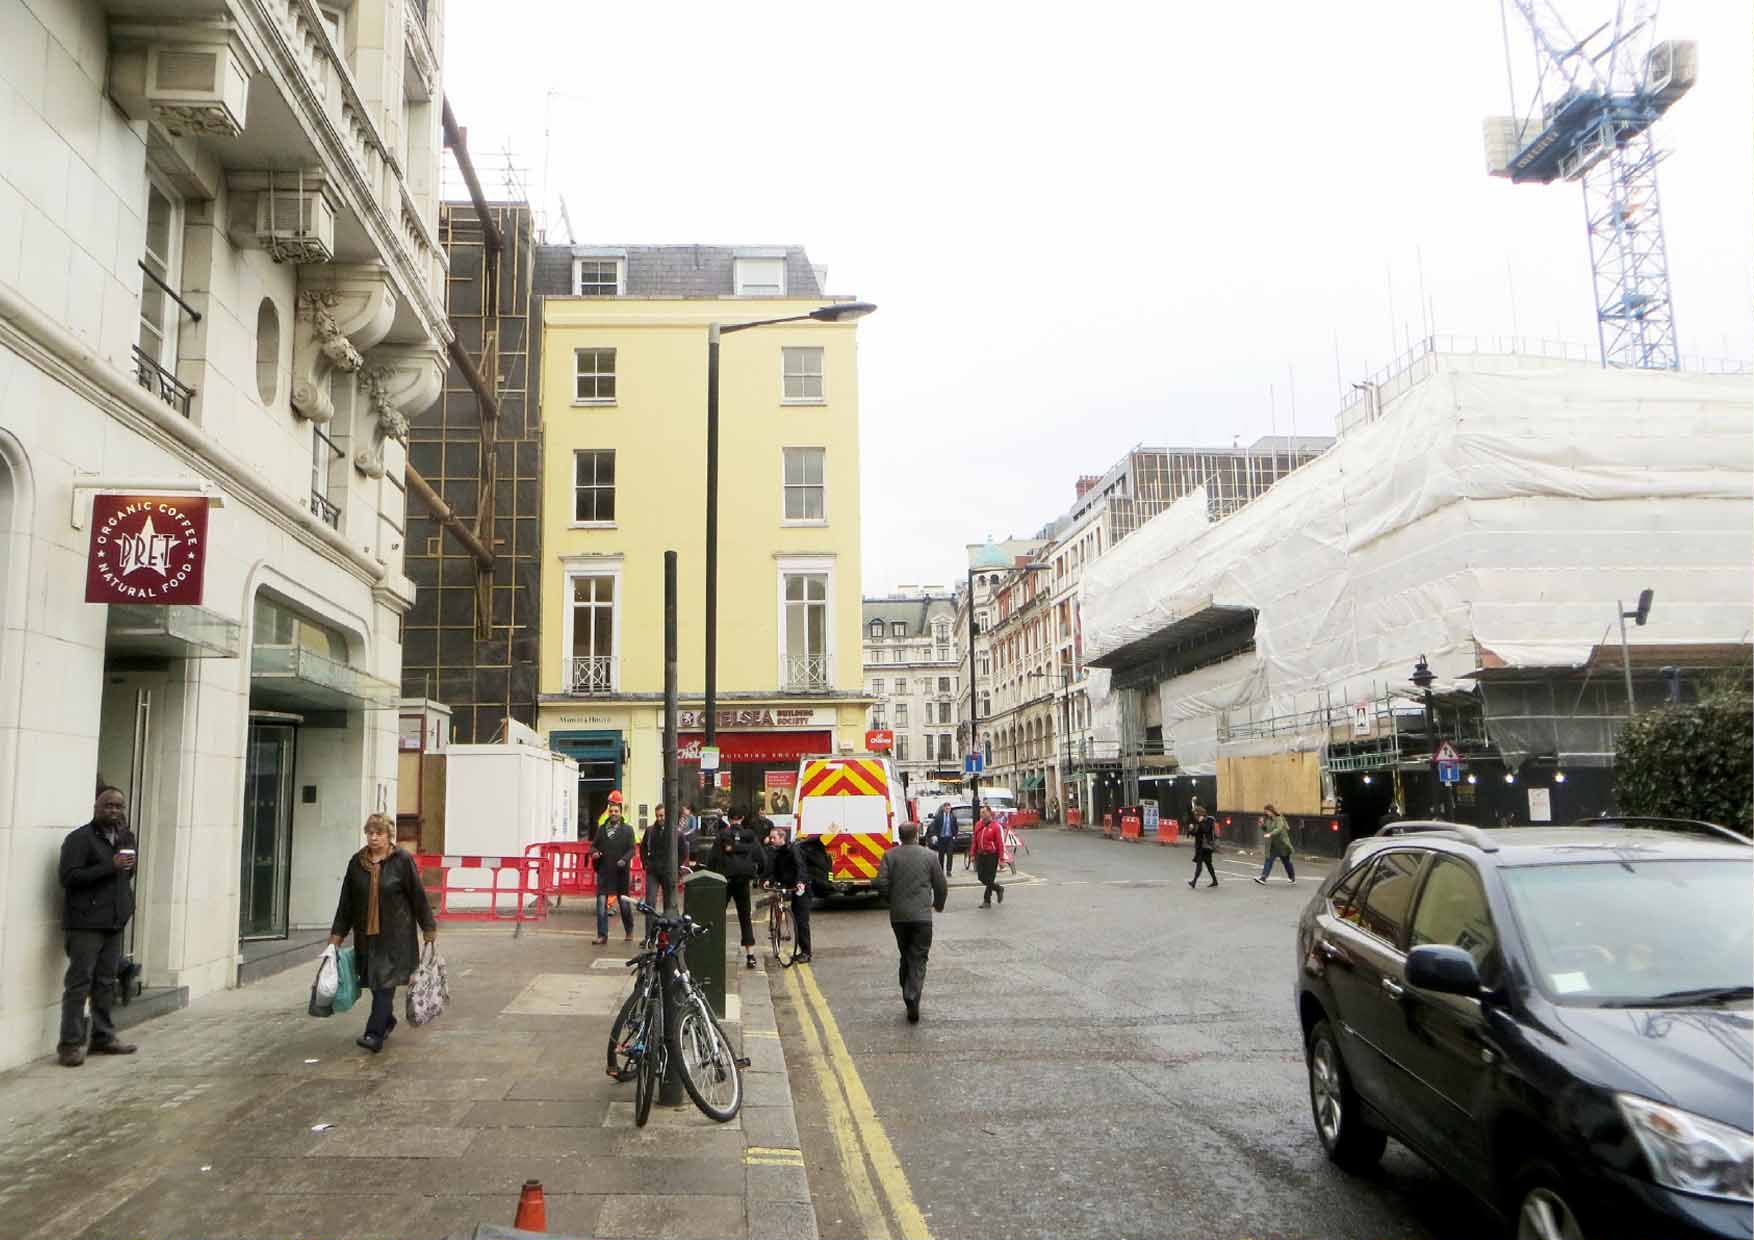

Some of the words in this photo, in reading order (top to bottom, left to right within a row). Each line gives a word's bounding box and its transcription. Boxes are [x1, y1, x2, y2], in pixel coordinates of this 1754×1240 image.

[97, 501, 152, 545] ORGANIC
[159, 503, 197, 546] COFFEE
[119, 532, 175, 568] PRET
[98, 562, 157, 598] NATURAL
[161, 563, 192, 593] FOOD
[777, 709, 814, 717] BUILDING
